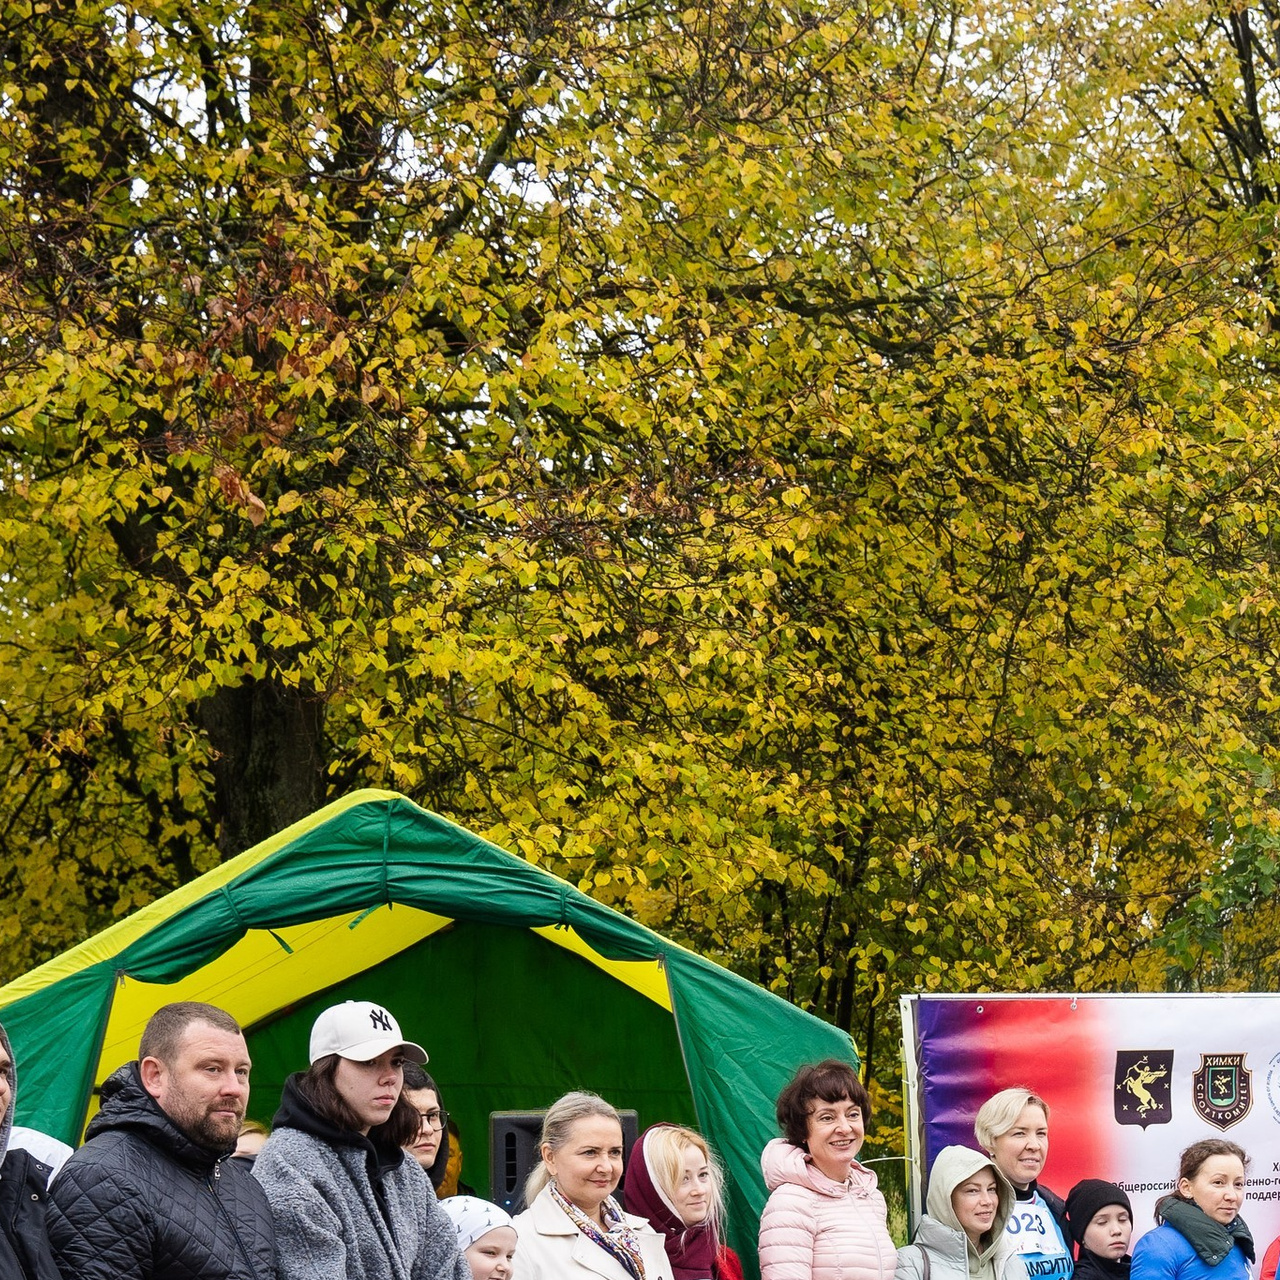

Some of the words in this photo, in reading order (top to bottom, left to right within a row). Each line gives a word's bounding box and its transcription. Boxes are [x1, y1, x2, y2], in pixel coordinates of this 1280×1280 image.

[1205, 1056, 1240, 1066] ХИМКИ
[1196, 1082, 1247, 1120] СПОРТКОМИТЕТ
[1006, 1212, 1046, 1235] 023
